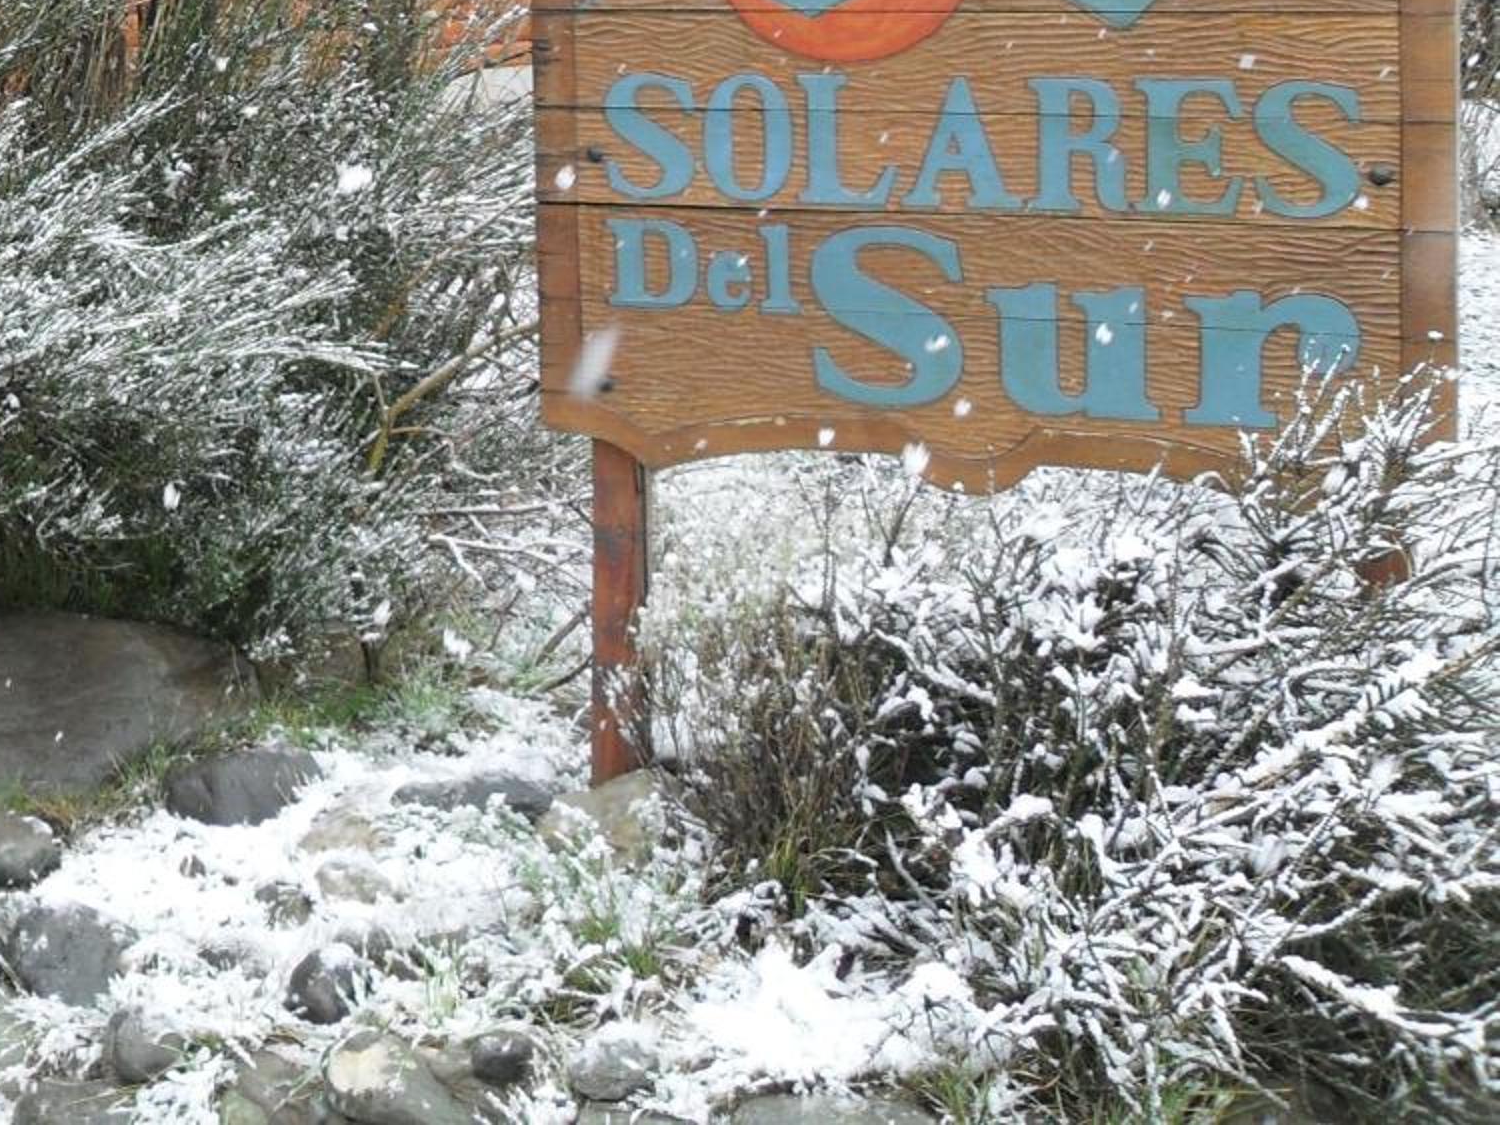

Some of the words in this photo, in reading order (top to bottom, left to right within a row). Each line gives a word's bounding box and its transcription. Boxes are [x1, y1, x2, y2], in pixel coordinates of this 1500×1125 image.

[603, 74, 1363, 218] SOLARES
[605, 219, 800, 313] Del
[810, 226, 1363, 429] Sur
